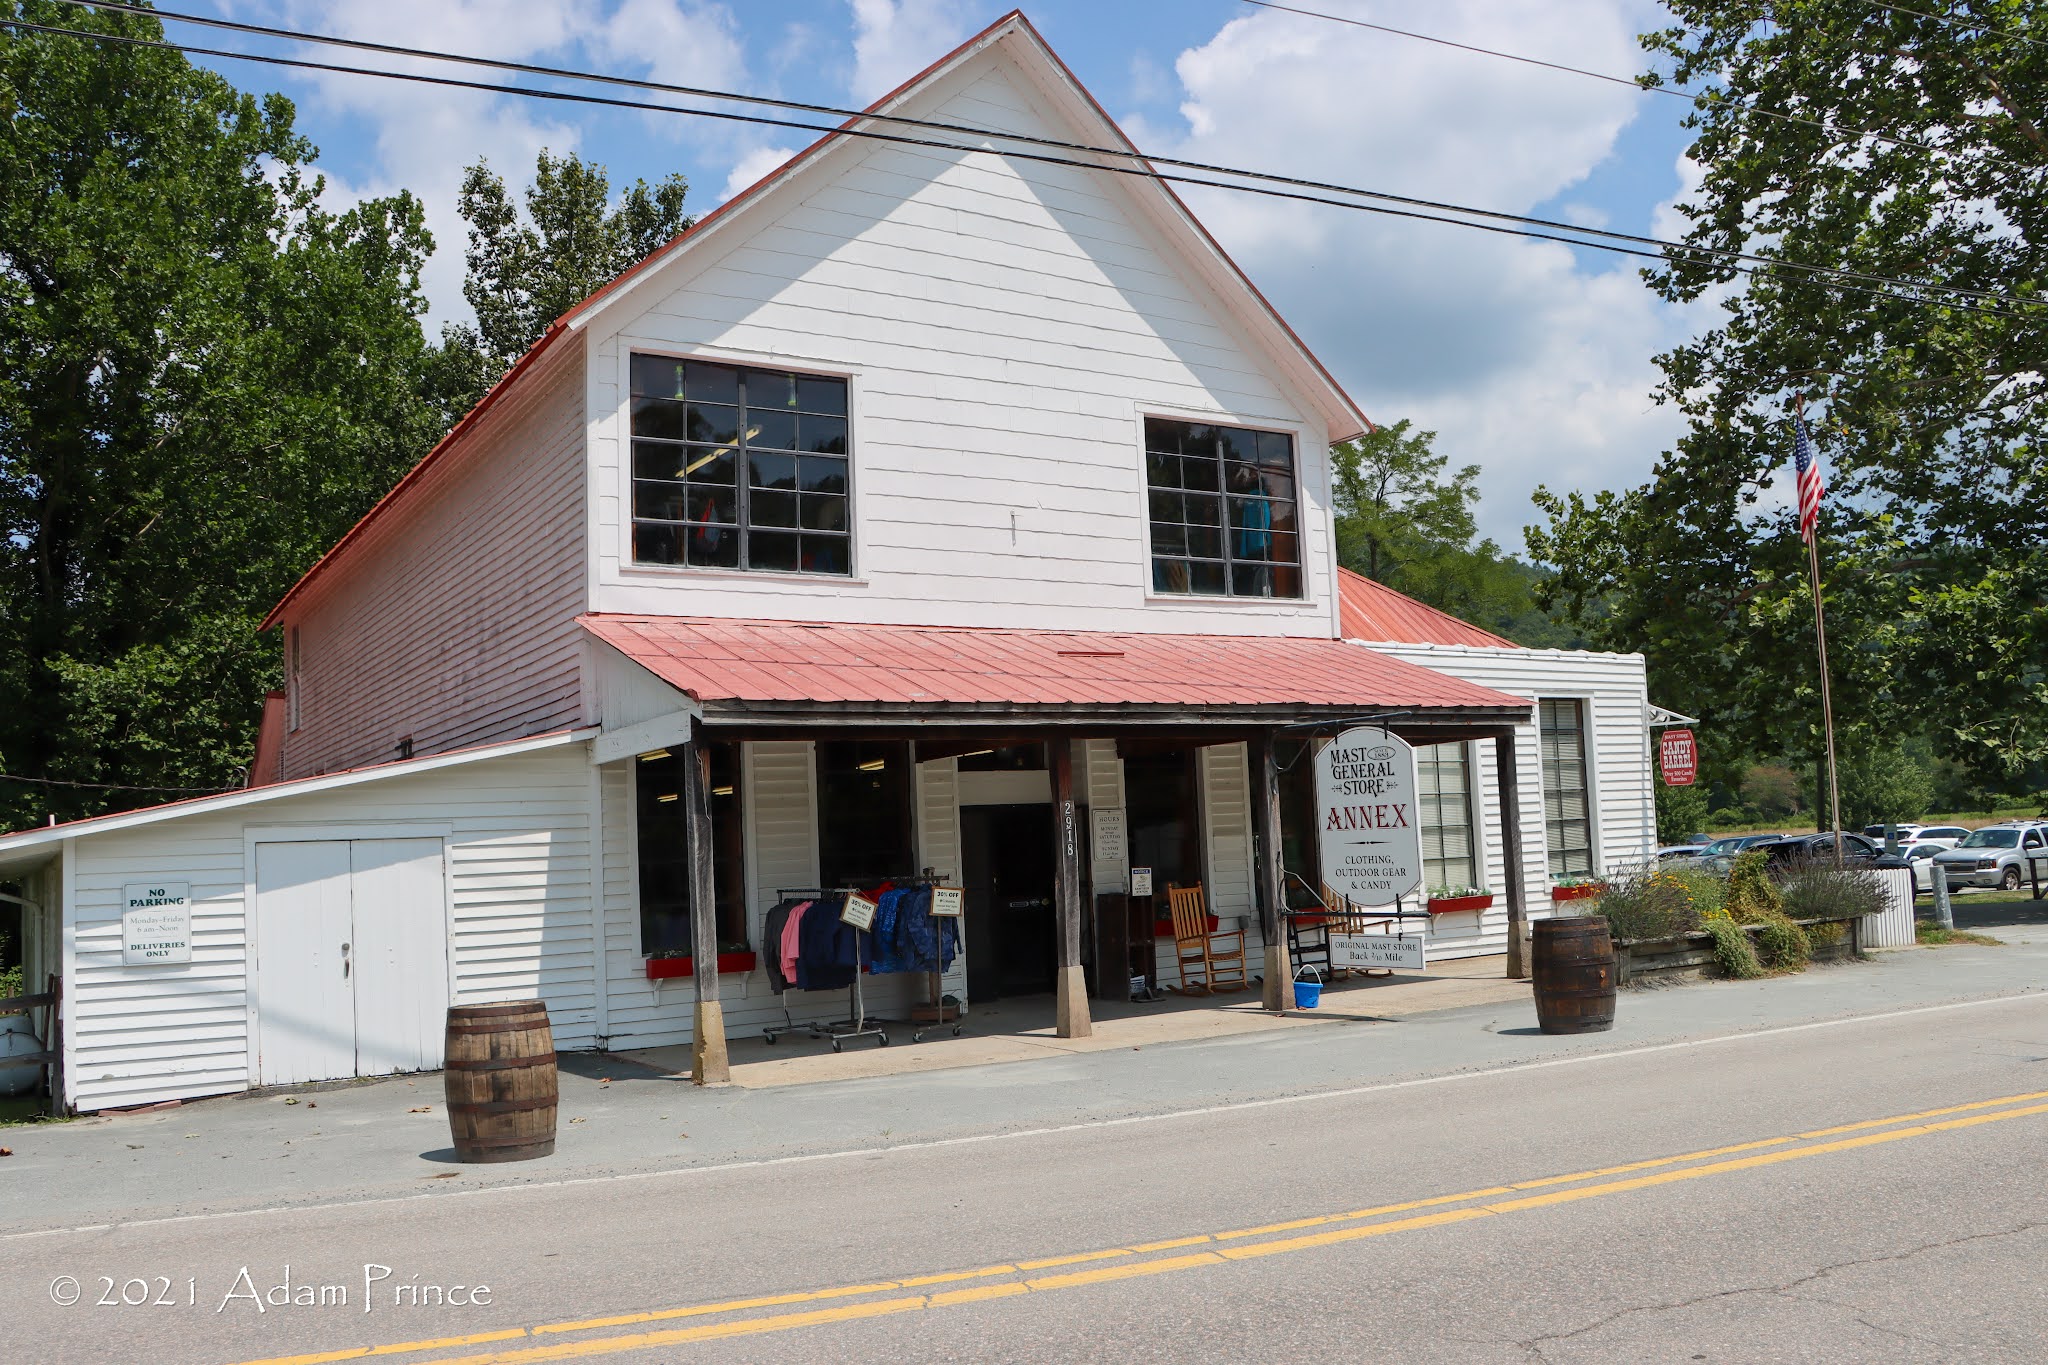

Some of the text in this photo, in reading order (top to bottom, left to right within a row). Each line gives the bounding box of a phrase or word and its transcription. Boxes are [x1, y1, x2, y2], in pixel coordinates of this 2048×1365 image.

[1663, 740, 1691, 755] CANDY
[1330, 747, 1367, 768] MAST
[1664, 754, 1692, 769] BARREL
[1332, 761, 1395, 780] GENERAL
[1343, 778, 1385, 798] STORE
[1326, 803, 1410, 831] ANNEX
[1065, 802, 1073, 855] 2918
[1345, 855, 1394, 865] CLOTHING,
[1335, 867, 1407, 877] OUTDOOR GEAR
[1351, 880, 1392, 890] & CANDY
[149, 888, 165, 897] NO
[130, 897, 184, 907] PARKING
[131, 942, 185, 950] DELIVERIES
[1335, 941, 1417, 952] ORIGINAL MAST STORE
[1349, 951, 1369, 961] Back
[1384, 952, 1403, 962] Mile
